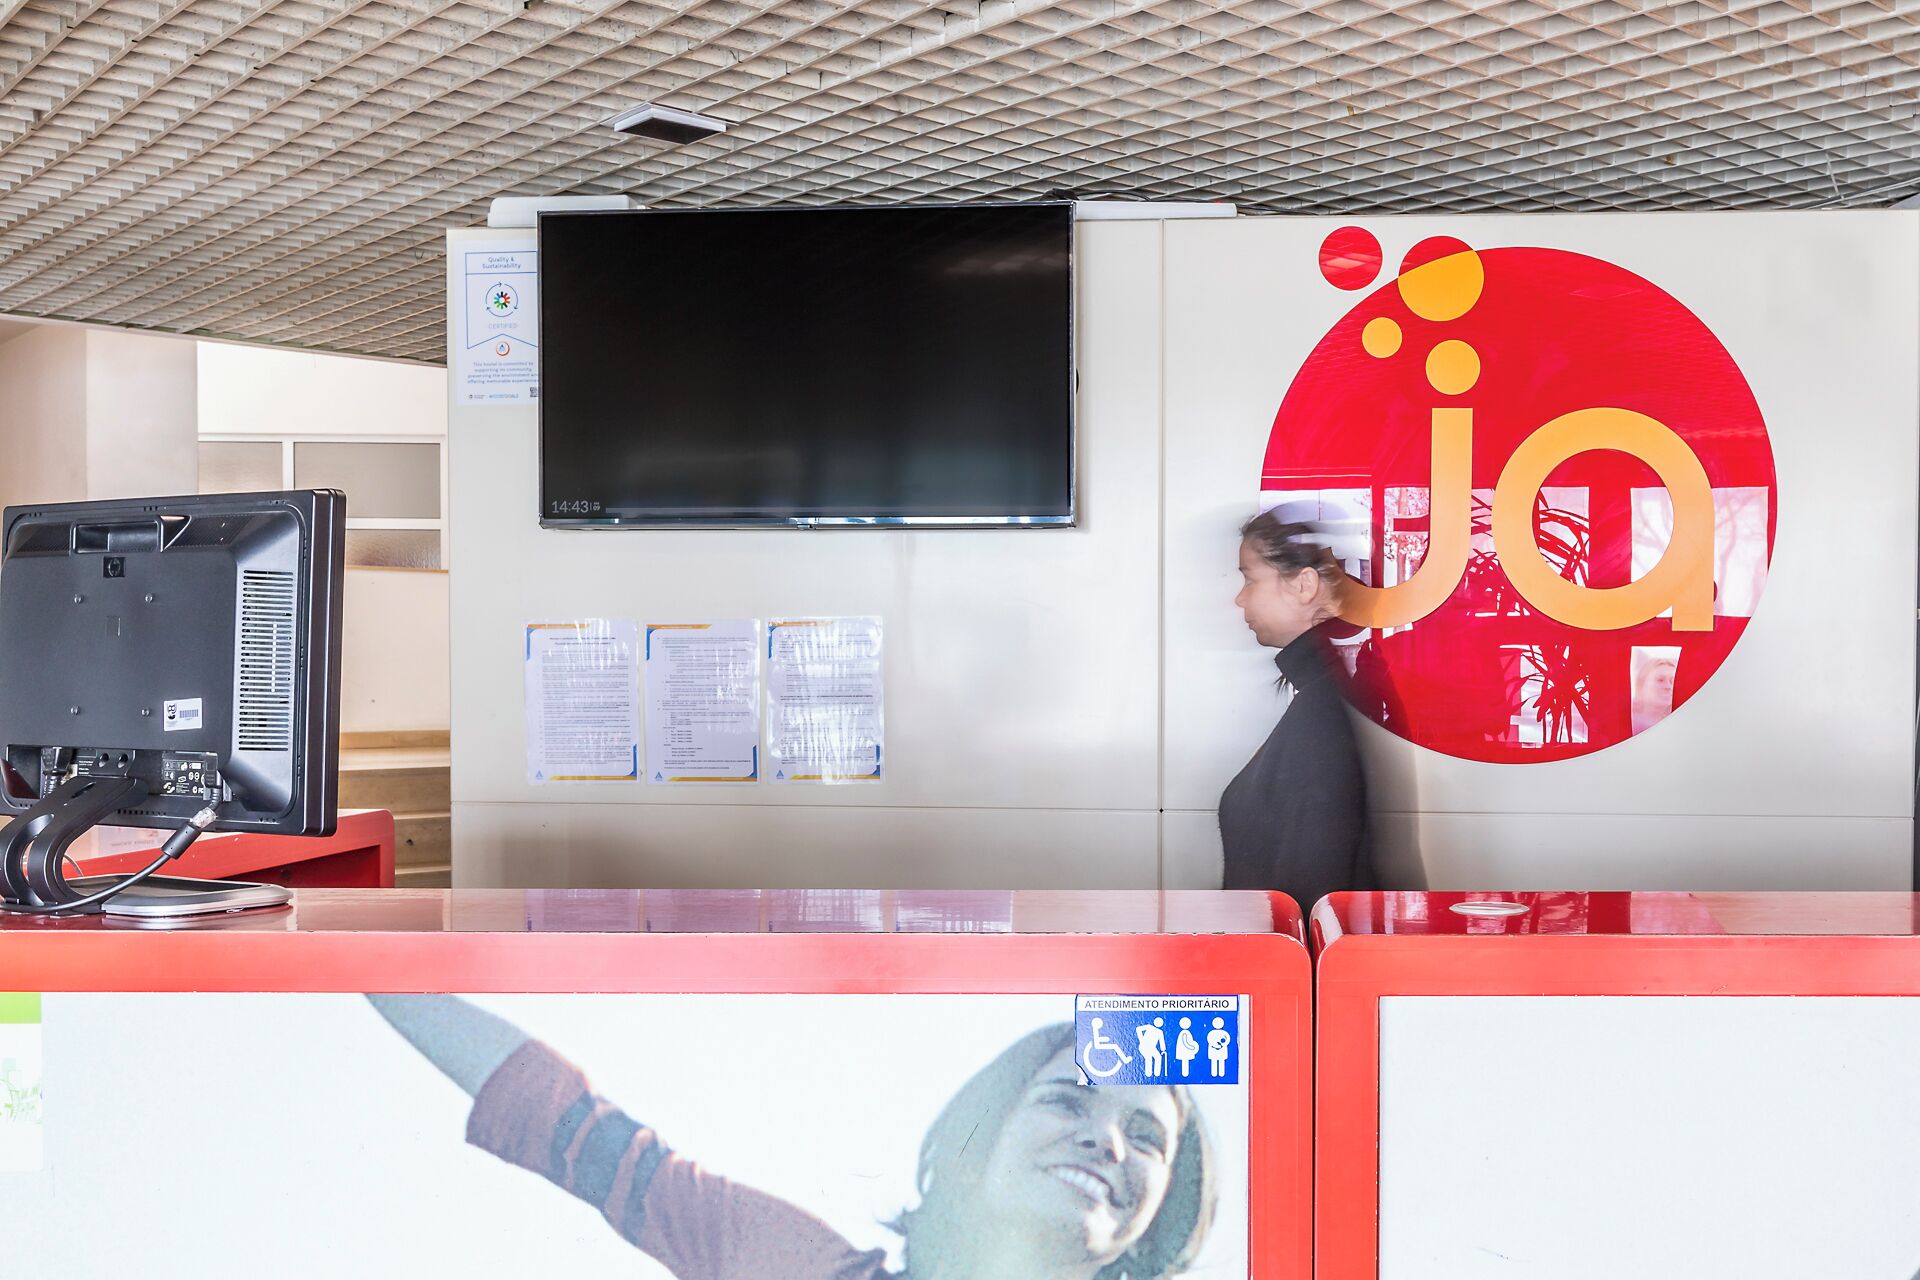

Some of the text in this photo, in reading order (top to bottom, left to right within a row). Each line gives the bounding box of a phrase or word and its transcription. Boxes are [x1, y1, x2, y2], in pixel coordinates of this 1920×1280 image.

[551, 500, 589, 513] 14:43
[1084, 997, 1230, 1009] ATENDIMENTO PRIORITÁRIO
